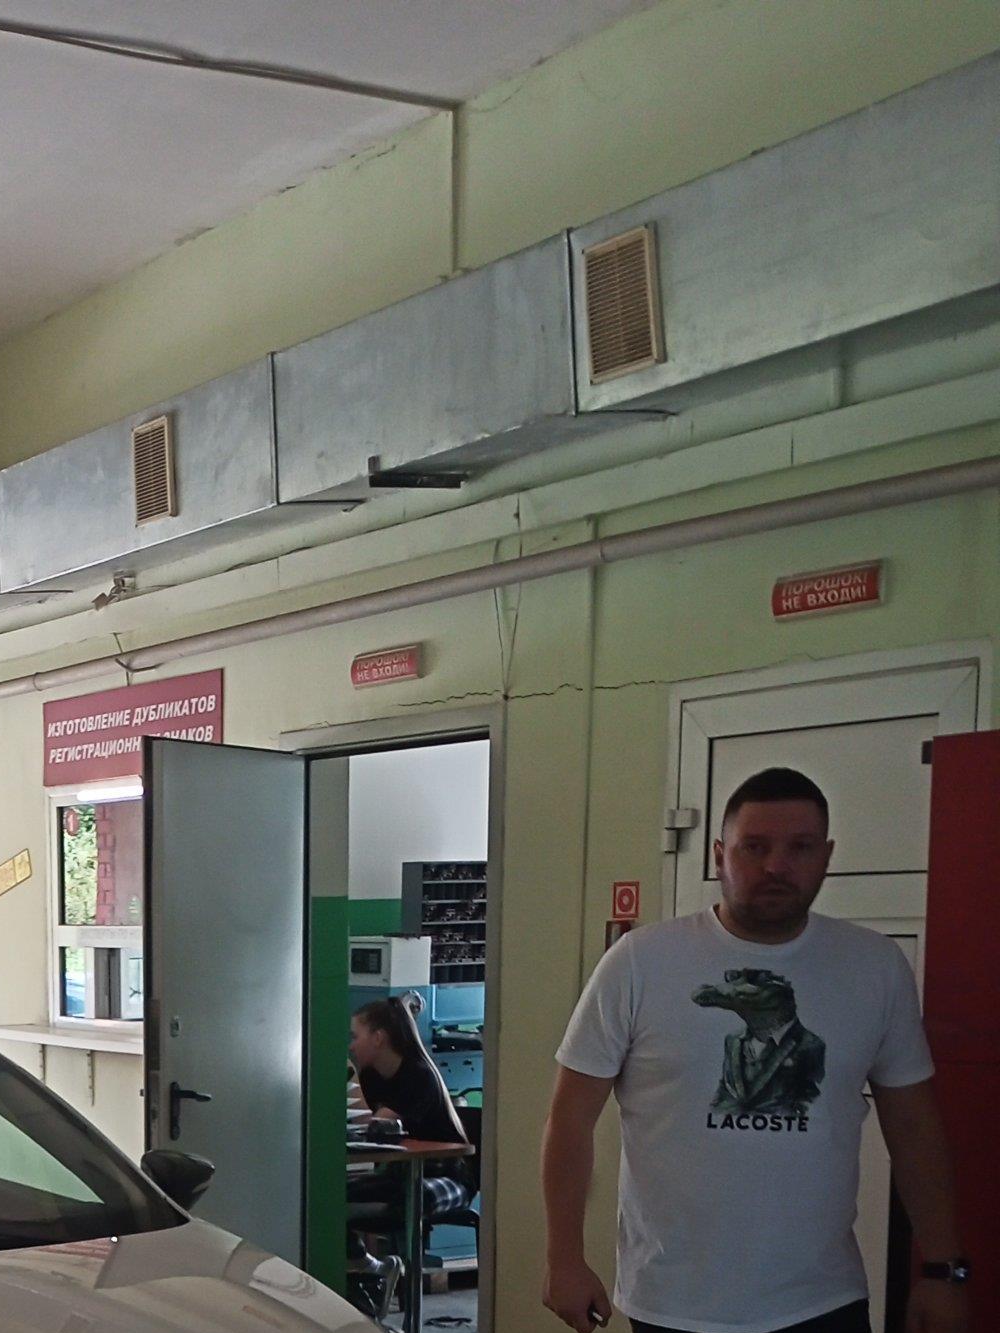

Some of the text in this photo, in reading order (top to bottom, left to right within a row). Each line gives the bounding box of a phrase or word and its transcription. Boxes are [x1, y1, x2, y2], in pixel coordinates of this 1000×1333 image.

[781, 584, 867, 611] НЕ ВХОДИ!
[356, 669, 370, 681] НЕ
[47, 694, 216, 738] ИЗГОТОВЛЕНИЕ ДУБЛИКАТОВ
[48, 732, 161, 764] РЕГИСТРАЦИОНН
[706, 1112, 809, 1132] LACOSTE
